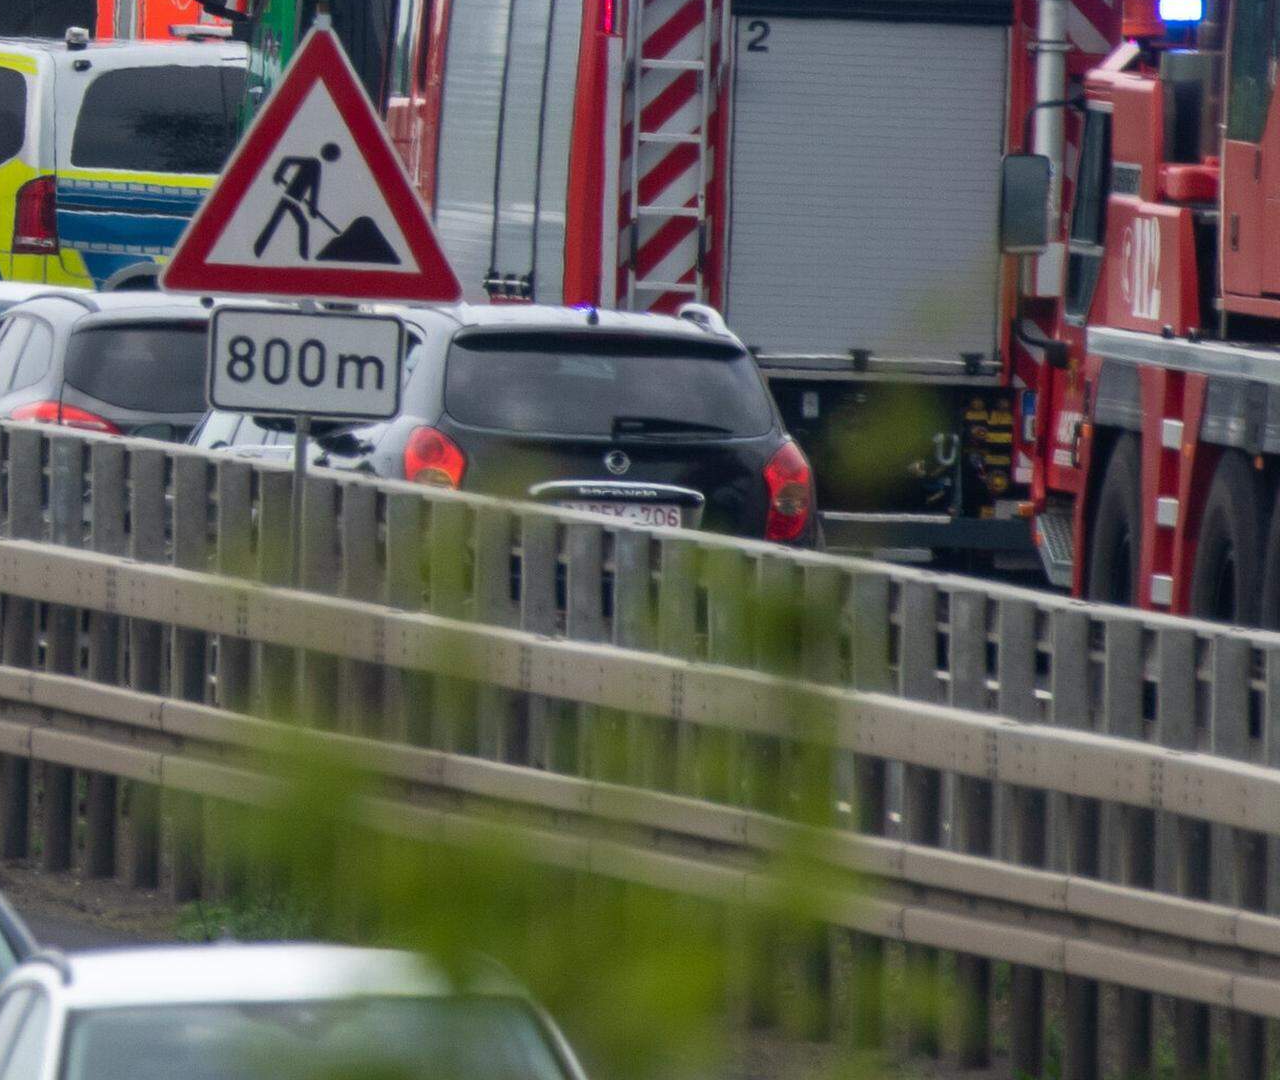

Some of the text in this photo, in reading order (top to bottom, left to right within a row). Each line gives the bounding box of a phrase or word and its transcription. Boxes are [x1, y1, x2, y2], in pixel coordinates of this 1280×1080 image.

[747, 20, 771, 52] 2
[226, 334, 385, 391] 800 m
